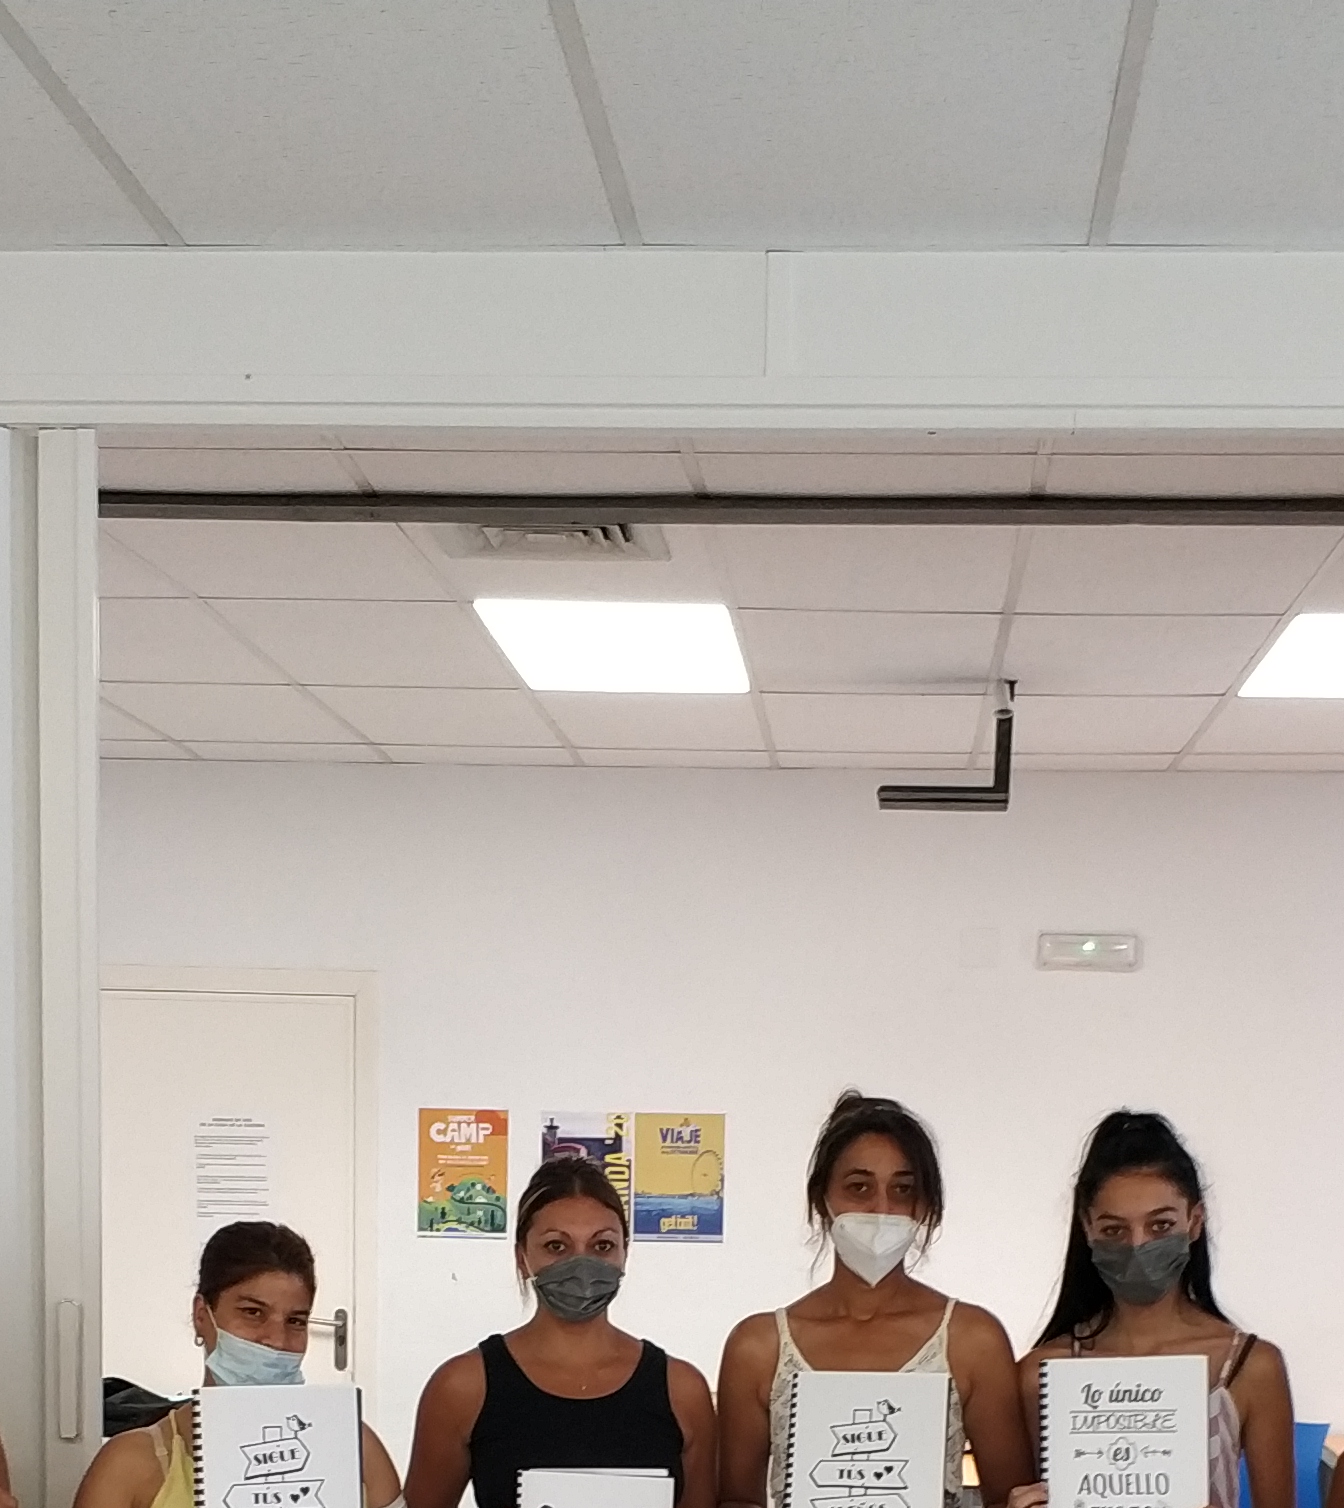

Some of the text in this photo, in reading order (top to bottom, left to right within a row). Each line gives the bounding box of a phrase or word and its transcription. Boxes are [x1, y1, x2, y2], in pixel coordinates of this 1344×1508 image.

[429, 1122, 493, 1143] CAMP
[659, 1128, 702, 1144] VIAJE
[1081, 1381, 1165, 1409] Lo único
[841, 1429, 887, 1446] SIGUE
[253, 1448, 301, 1466] SIGUE
[1112, 1446, 1131, 1462] es
[1077, 1472, 1171, 1498] AQUELLO
